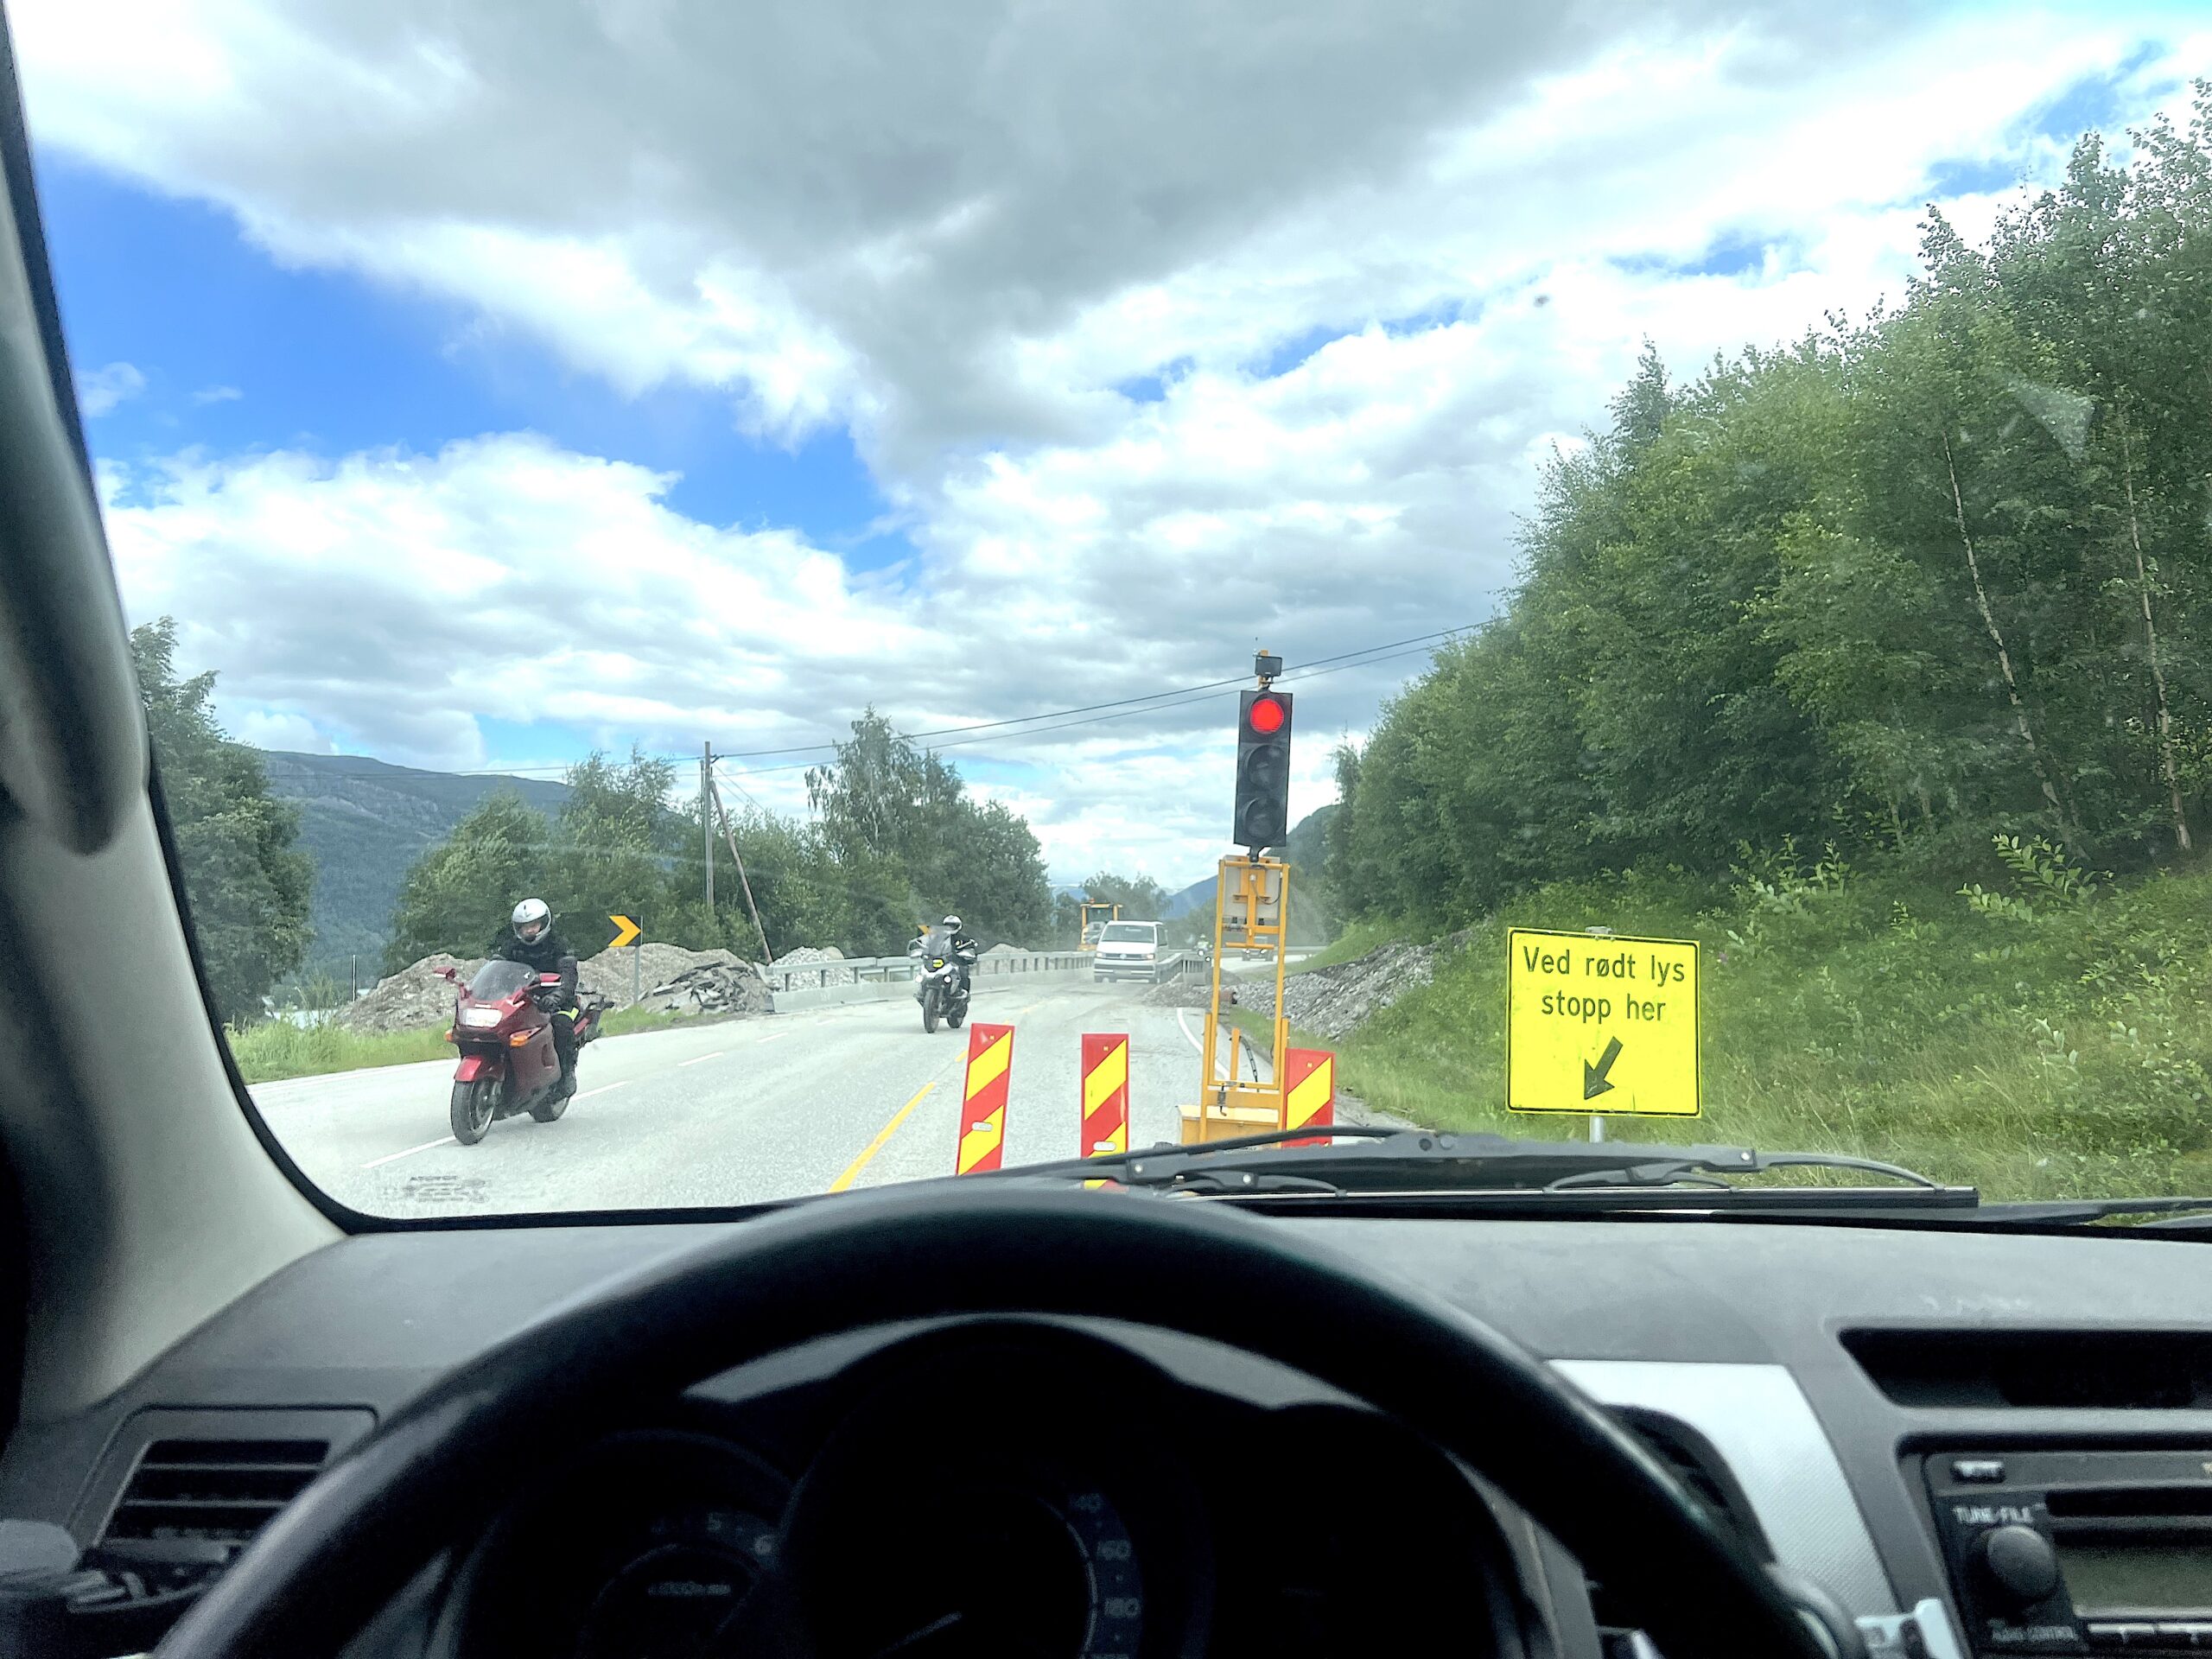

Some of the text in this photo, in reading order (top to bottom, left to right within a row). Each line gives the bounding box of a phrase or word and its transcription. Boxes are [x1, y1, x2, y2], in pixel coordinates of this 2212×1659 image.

[1523, 945, 1685, 987] Ved rødt lys
[1541, 990, 1666, 1024] stopp her
